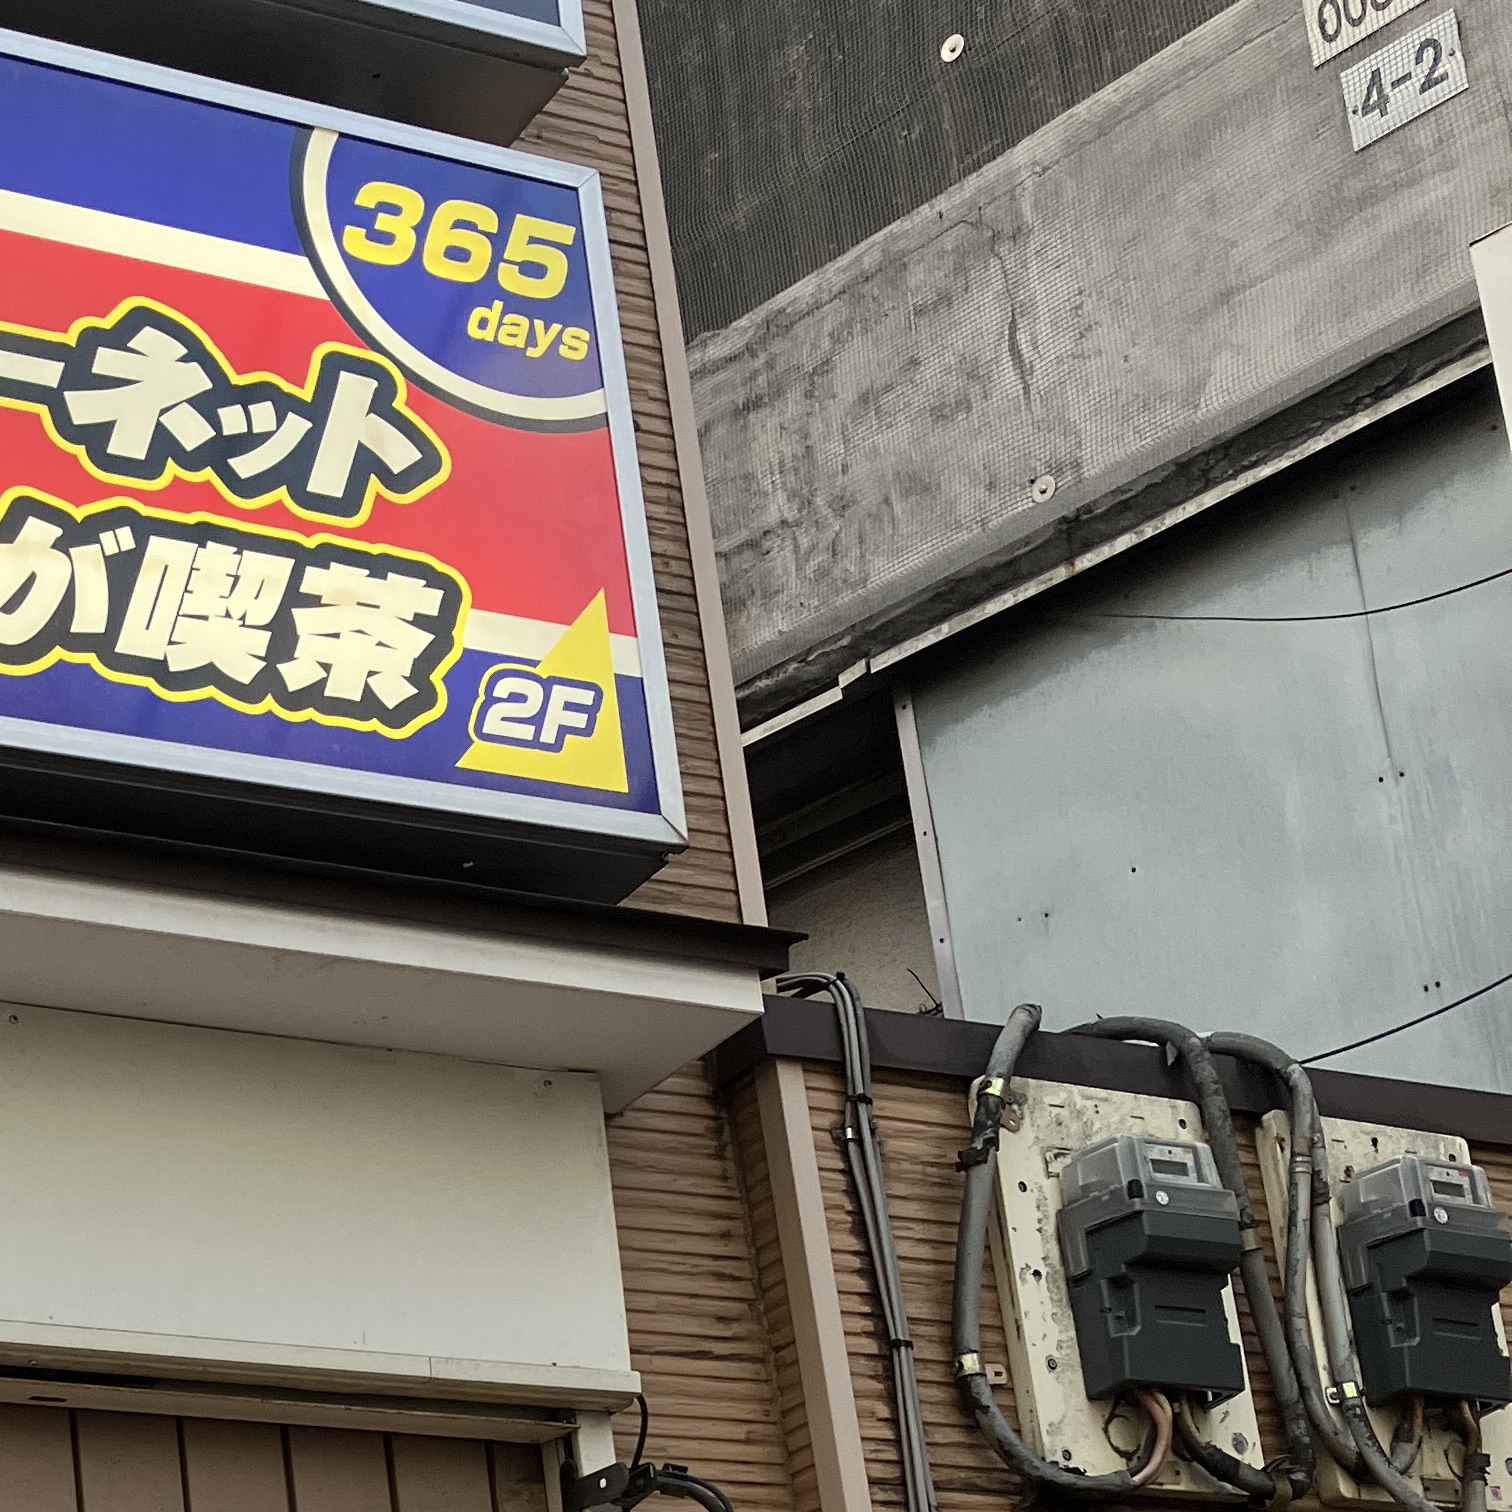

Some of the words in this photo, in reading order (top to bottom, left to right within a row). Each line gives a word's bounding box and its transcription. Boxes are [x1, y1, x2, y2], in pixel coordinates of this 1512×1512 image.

[1318, 0, 1391, 43] 00
[1361, 38, 1449, 118] 4-2
[342, 181, 577, 299] 365
[467, 301, 590, 361] days
[483, 677, 598, 744] 2F
